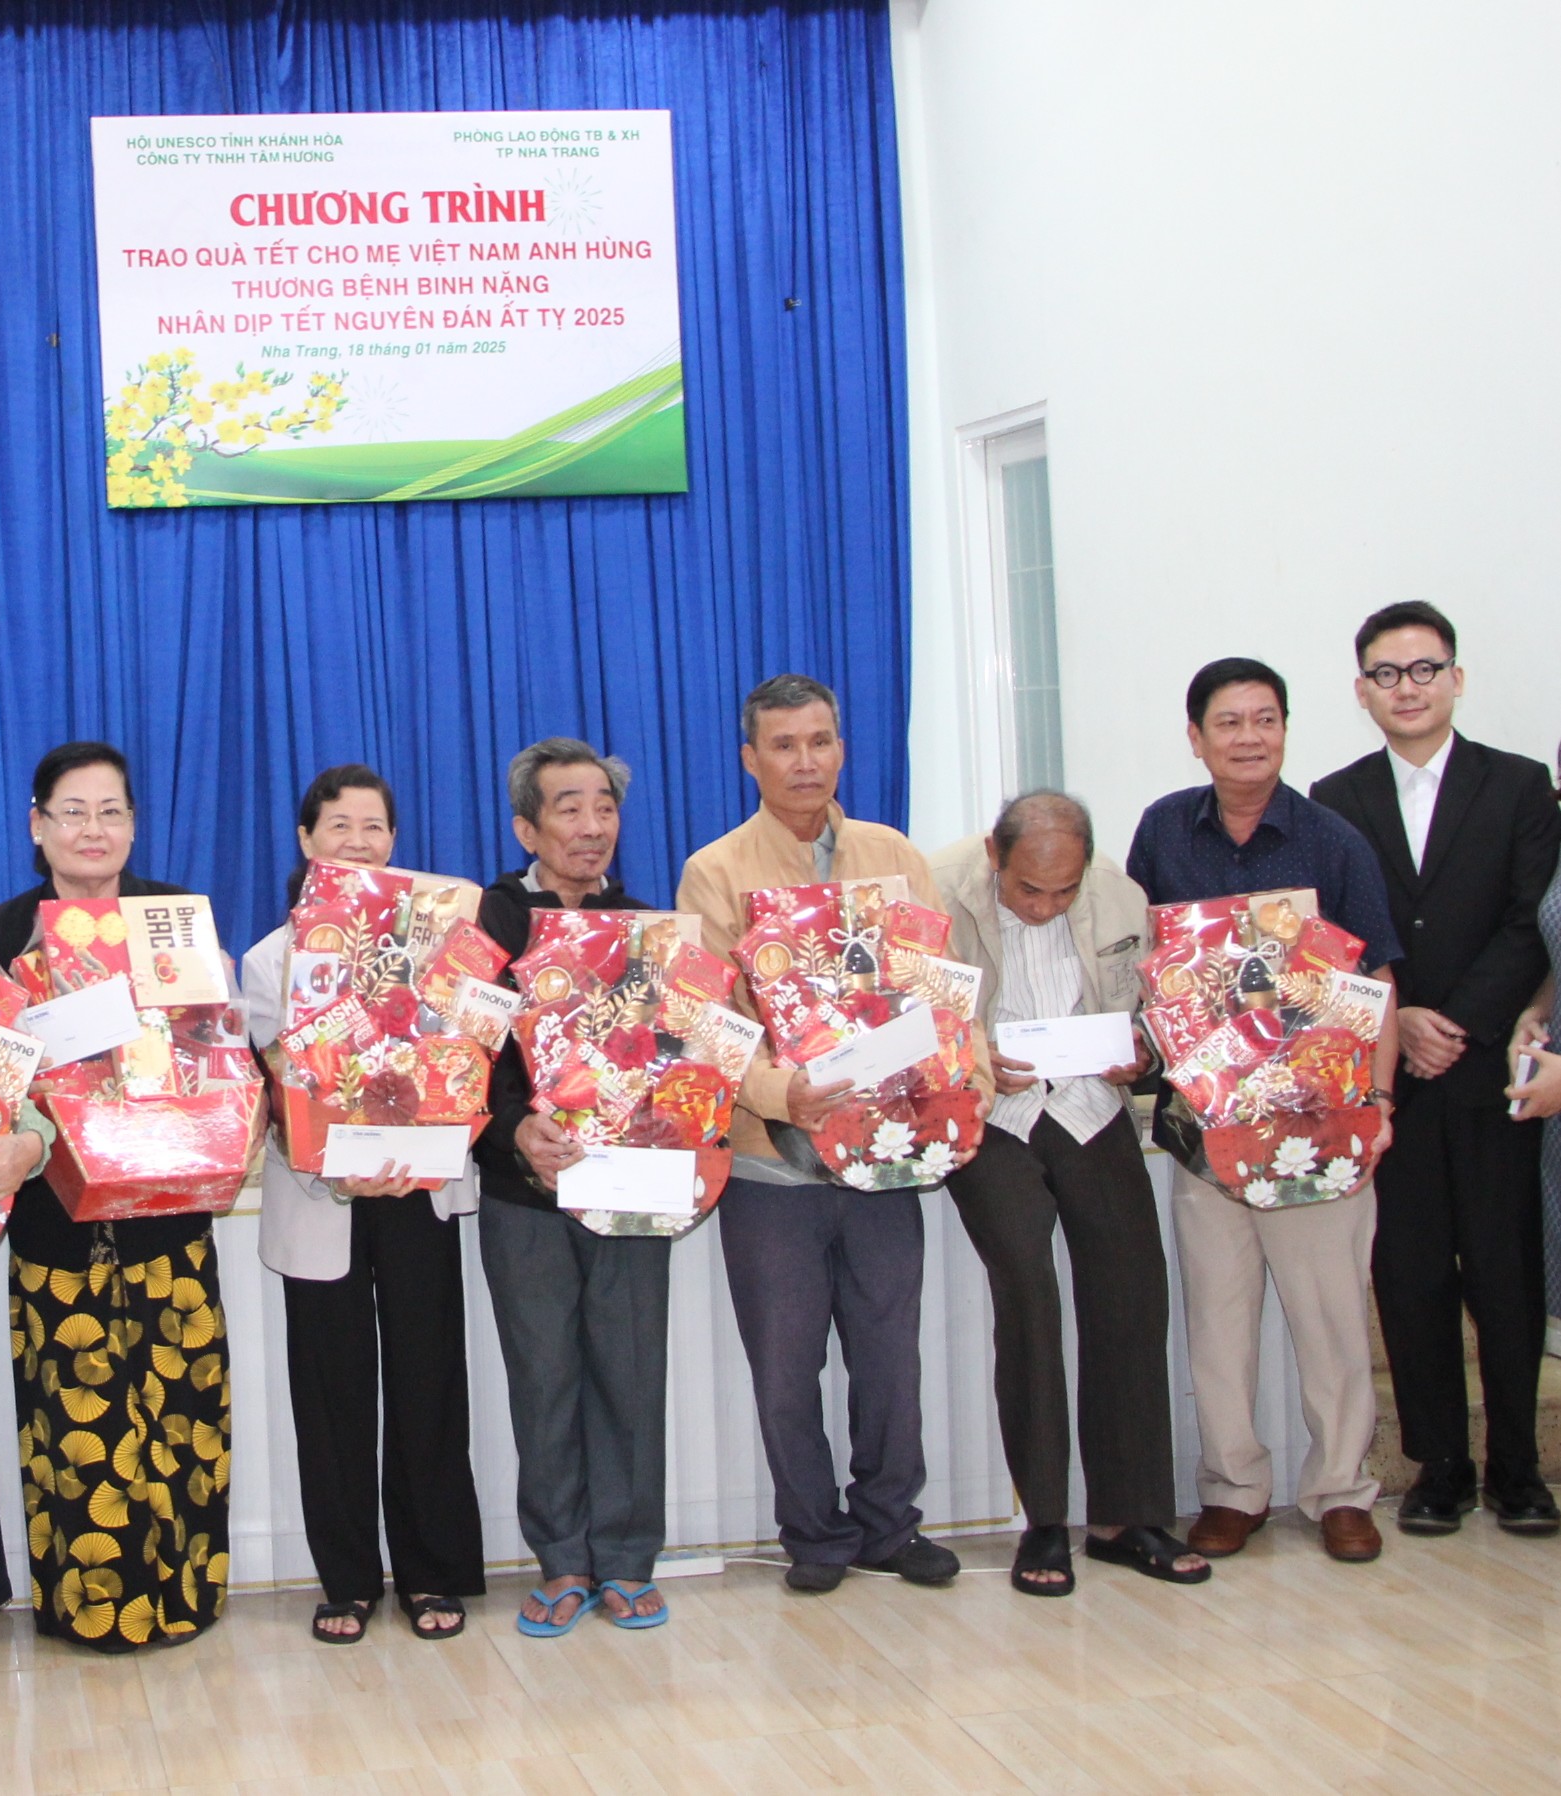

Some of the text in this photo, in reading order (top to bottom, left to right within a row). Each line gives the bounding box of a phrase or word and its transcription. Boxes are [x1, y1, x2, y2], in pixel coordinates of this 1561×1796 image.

[127, 132, 344, 150] HỘI UNESCO TỈNH KHÁNH HÒA
[453, 128, 640, 145] PHÒNG LAO ĐỘNG TB & XH
[137, 150, 335, 166] CÔNG TY TNHH TÂM HƯƠNG
[496, 146, 600, 159] TP NHA TRANG
[230, 183, 546, 226] CHƯƠNG TRÌNH
[122, 236, 652, 268] TRAO QUÀ TẾT CHO MẸ VIỆT NAM ANH HÙNG
[232, 271, 550, 300] THƯƠNG BỆNH BINH NẶNG
[157, 300, 625, 337] NHÂN DỊP TẾT NGUYÊN ĐÁN ẤT TỴ 2025
[261, 341, 508, 361] Nha Trang, 18 tháng 01 năm 2025
[479, 990, 513, 1009] mone
[1349, 983, 1383, 999] mone
[724, 1019, 755, 1040] mone
